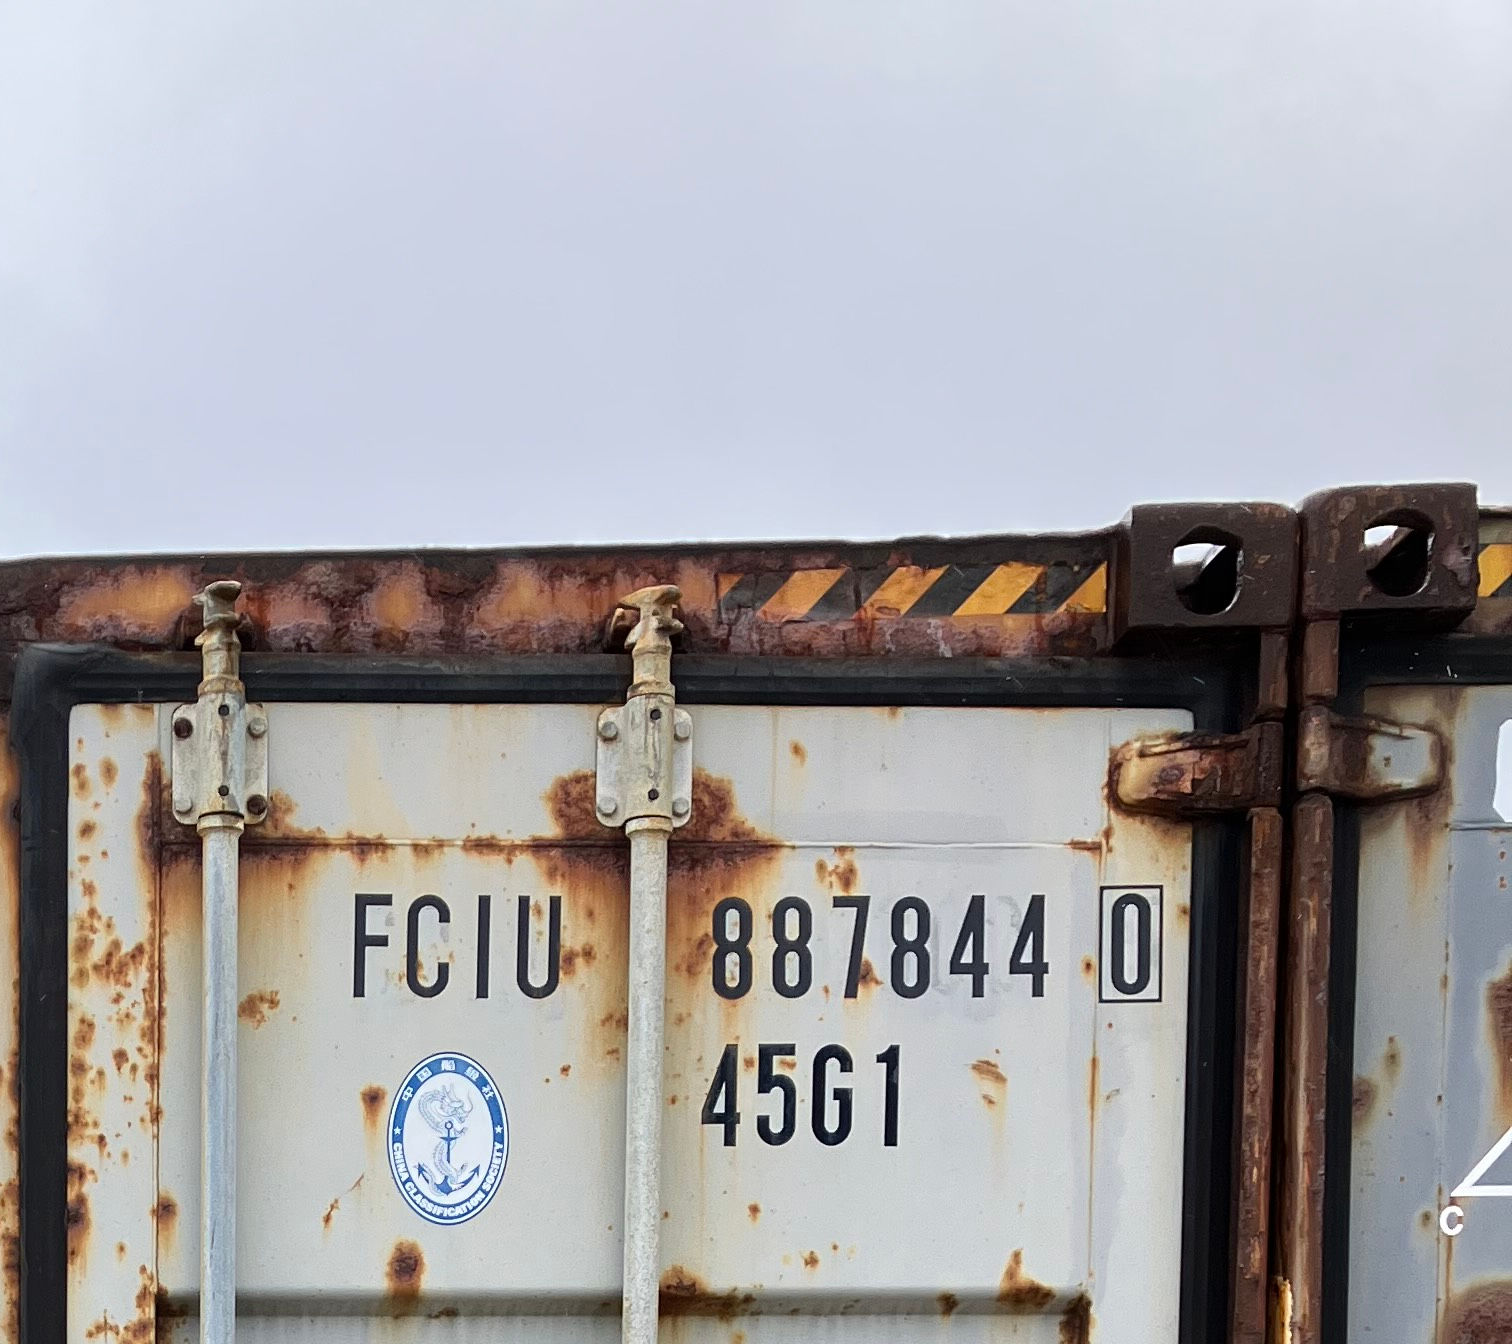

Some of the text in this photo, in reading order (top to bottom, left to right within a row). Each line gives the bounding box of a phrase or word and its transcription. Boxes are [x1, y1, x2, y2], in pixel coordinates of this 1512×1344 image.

[353, 893, 1151, 999] FCIU 887844 0
[701, 1043, 903, 1148] 45G1
[393, 1141, 503, 1217] CHINA CLASSIFICATION SOCIETY
